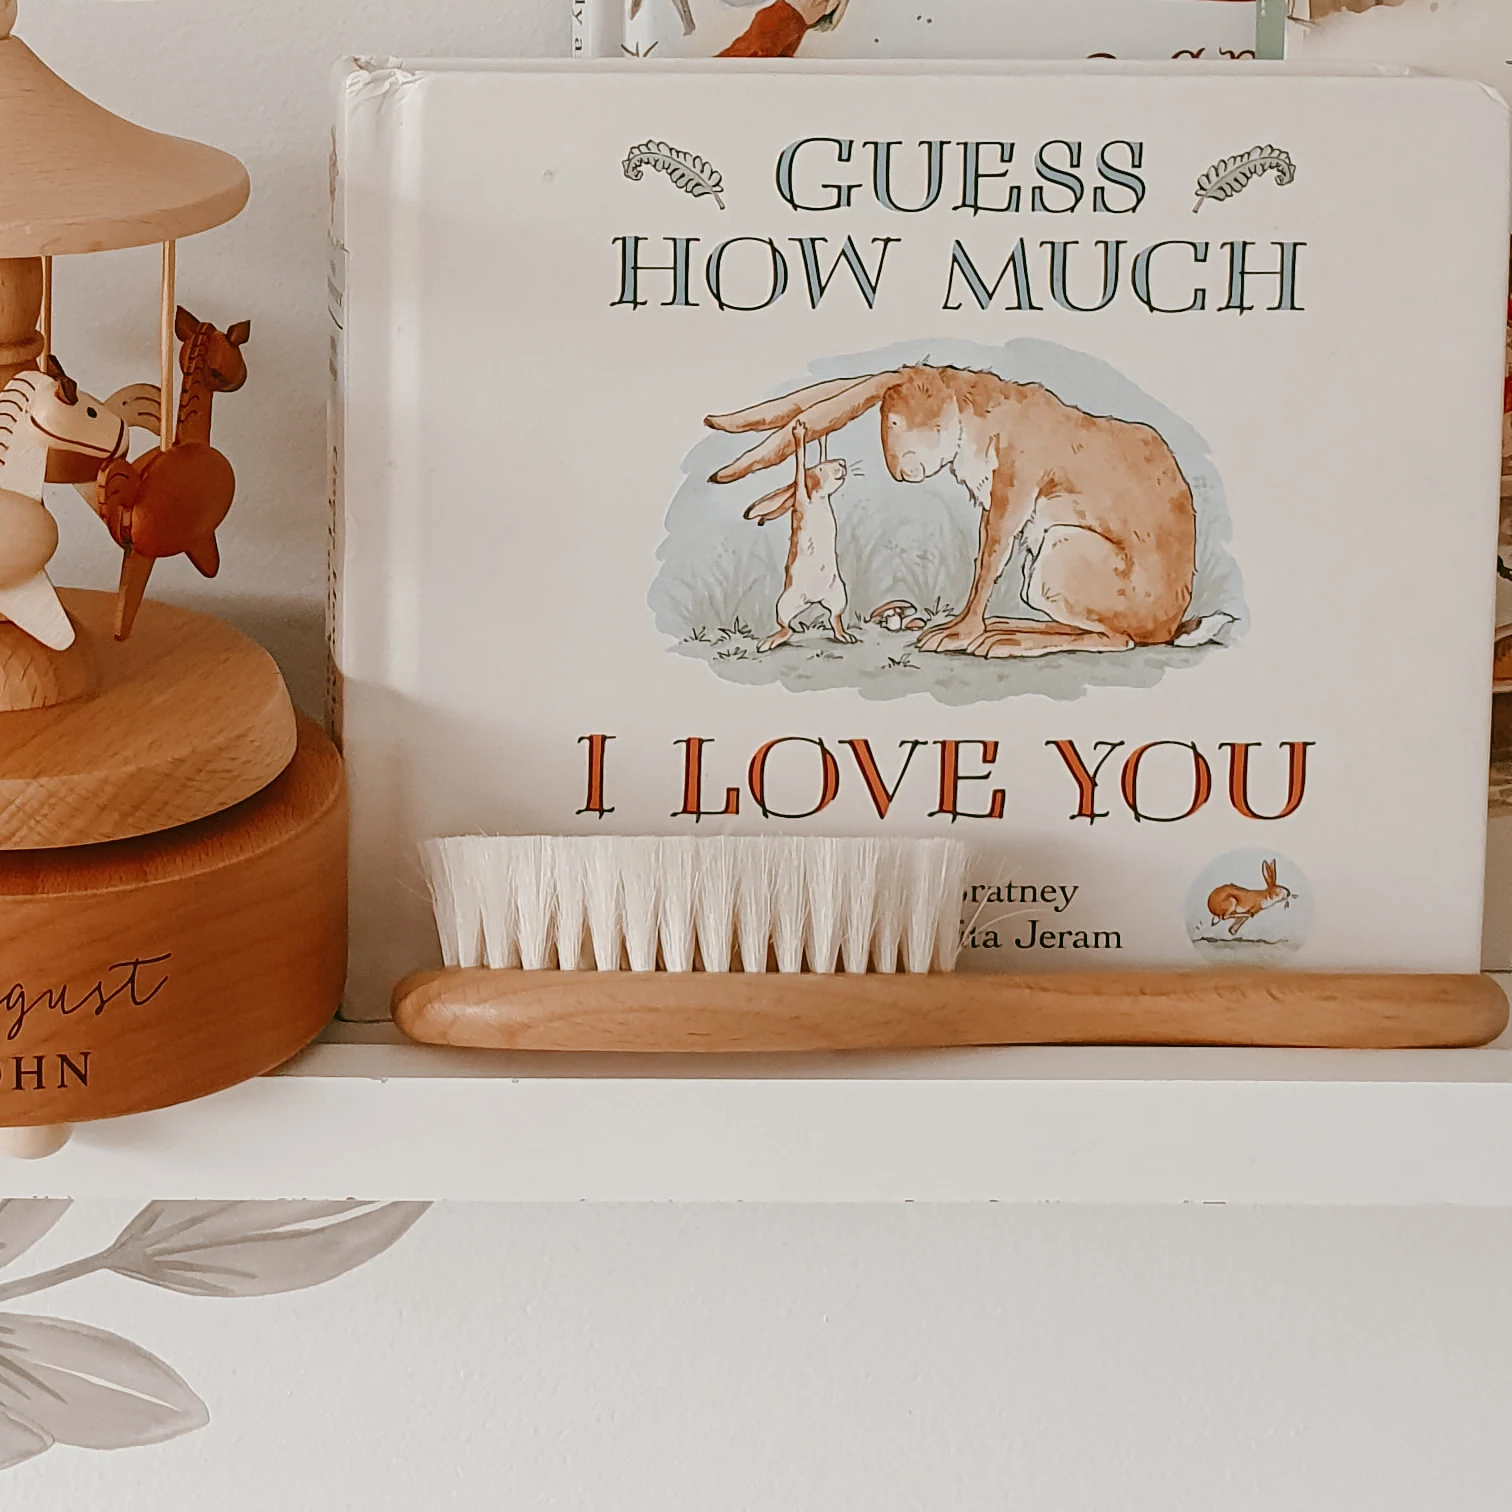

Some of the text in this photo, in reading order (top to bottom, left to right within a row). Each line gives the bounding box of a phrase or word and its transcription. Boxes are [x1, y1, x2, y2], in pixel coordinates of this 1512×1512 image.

[776, 137, 1146, 218] GUESS
[609, 234, 1308, 315] HOW MUCH
[575, 734, 1317, 826] I LOVE YOU
[959, 919, 1123, 949] ita Jeram
[962, 880, 1079, 913] ratney
